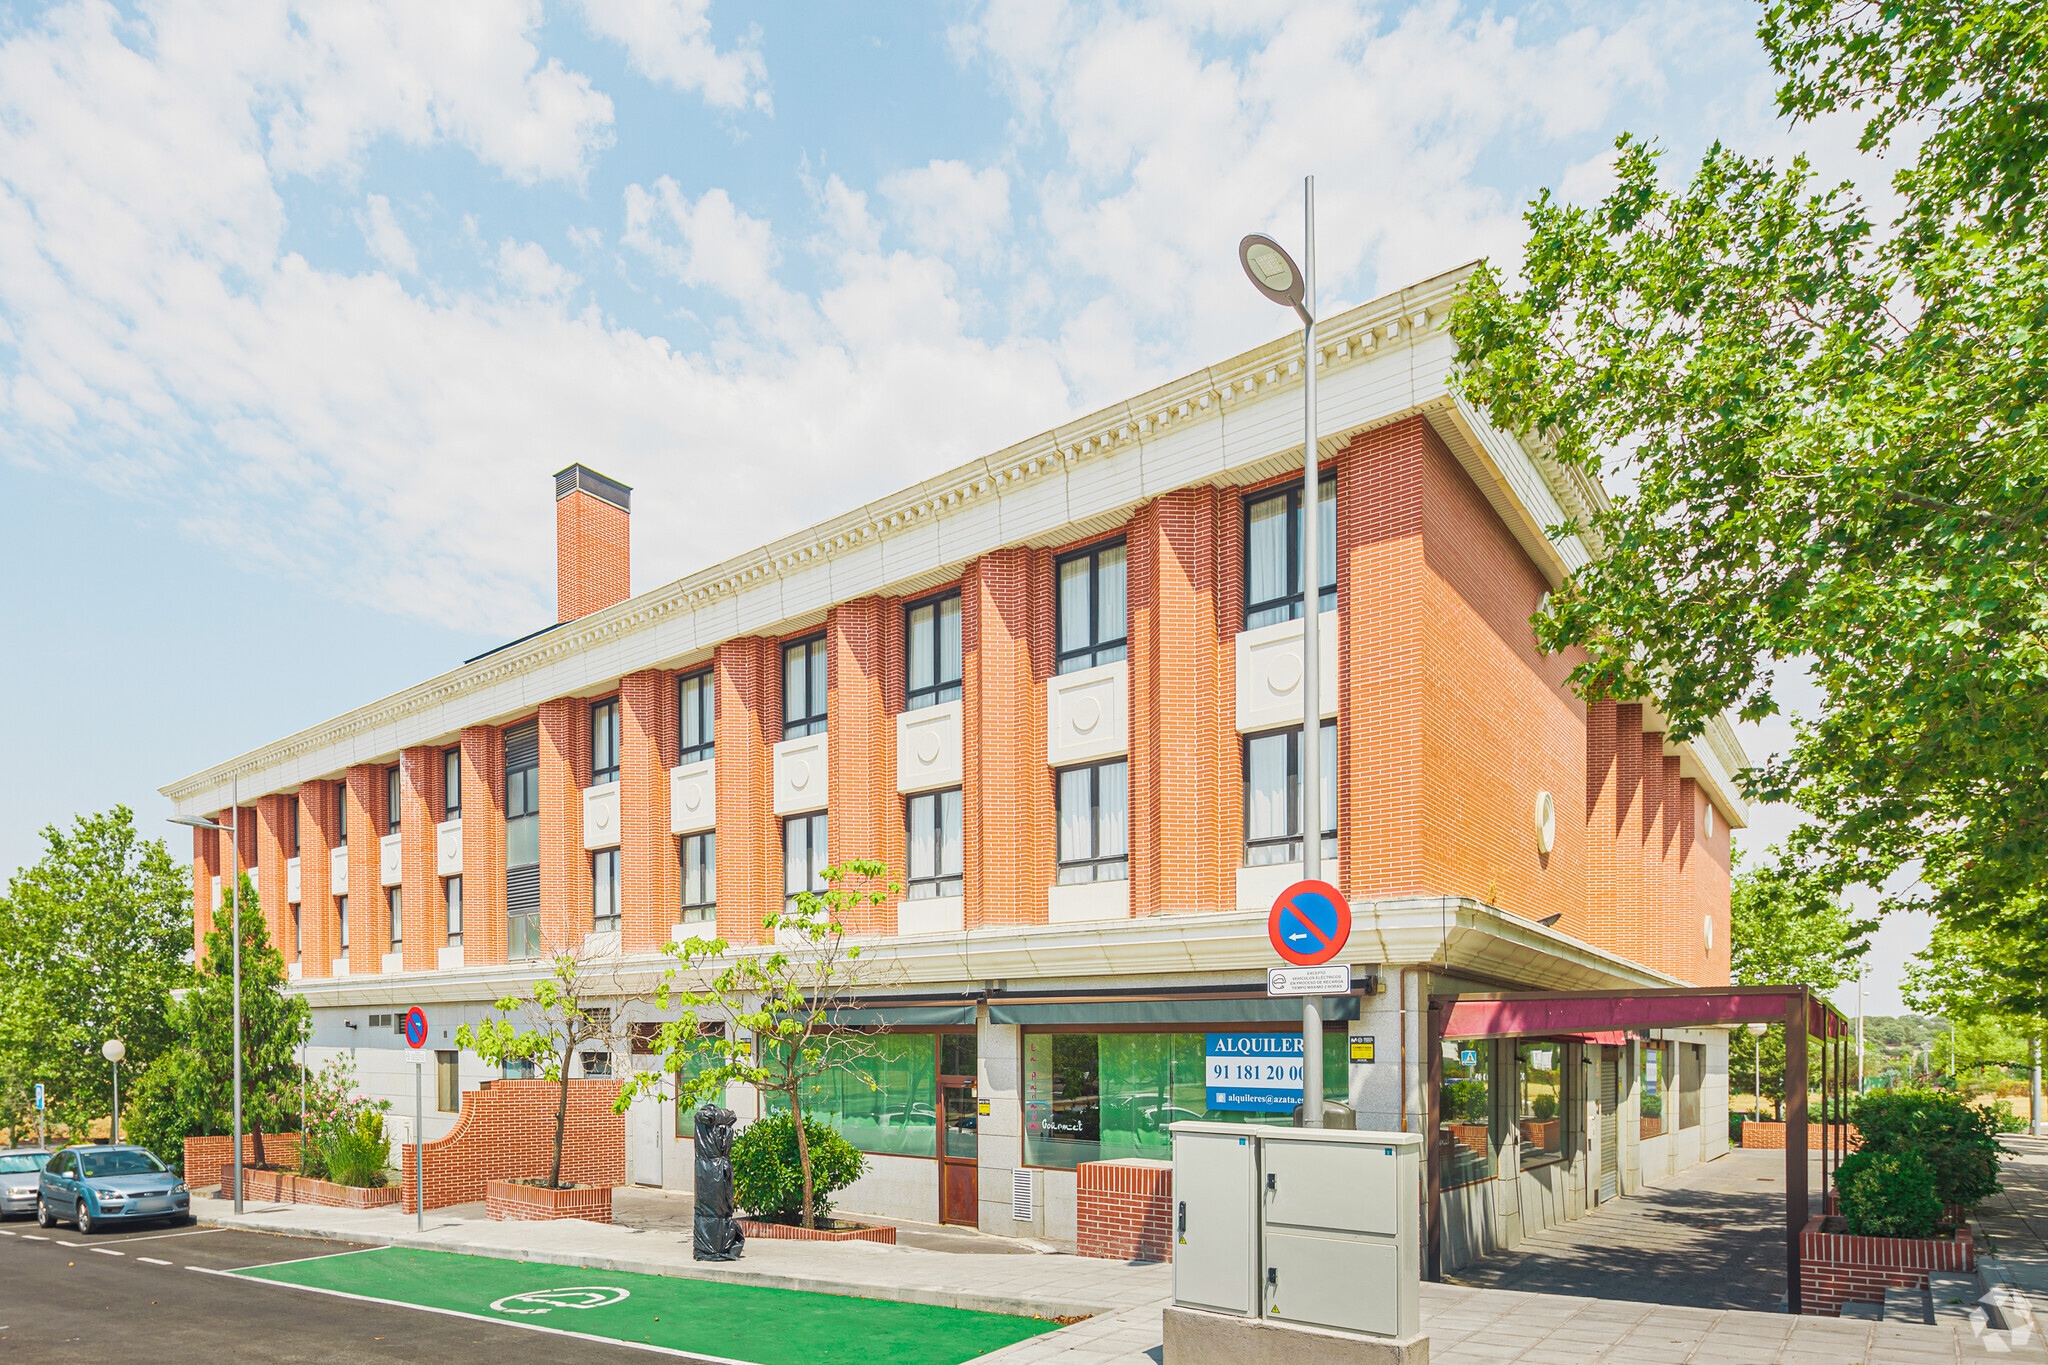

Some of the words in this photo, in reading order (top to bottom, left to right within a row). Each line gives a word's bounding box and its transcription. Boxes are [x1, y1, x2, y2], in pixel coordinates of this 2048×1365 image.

[1215, 1038, 1304, 1054] ALQUILER
[1214, 1064, 1229, 1079] 91
[1237, 1065, 1260, 1080] 181
[1266, 1065, 1284, 1080] 20
